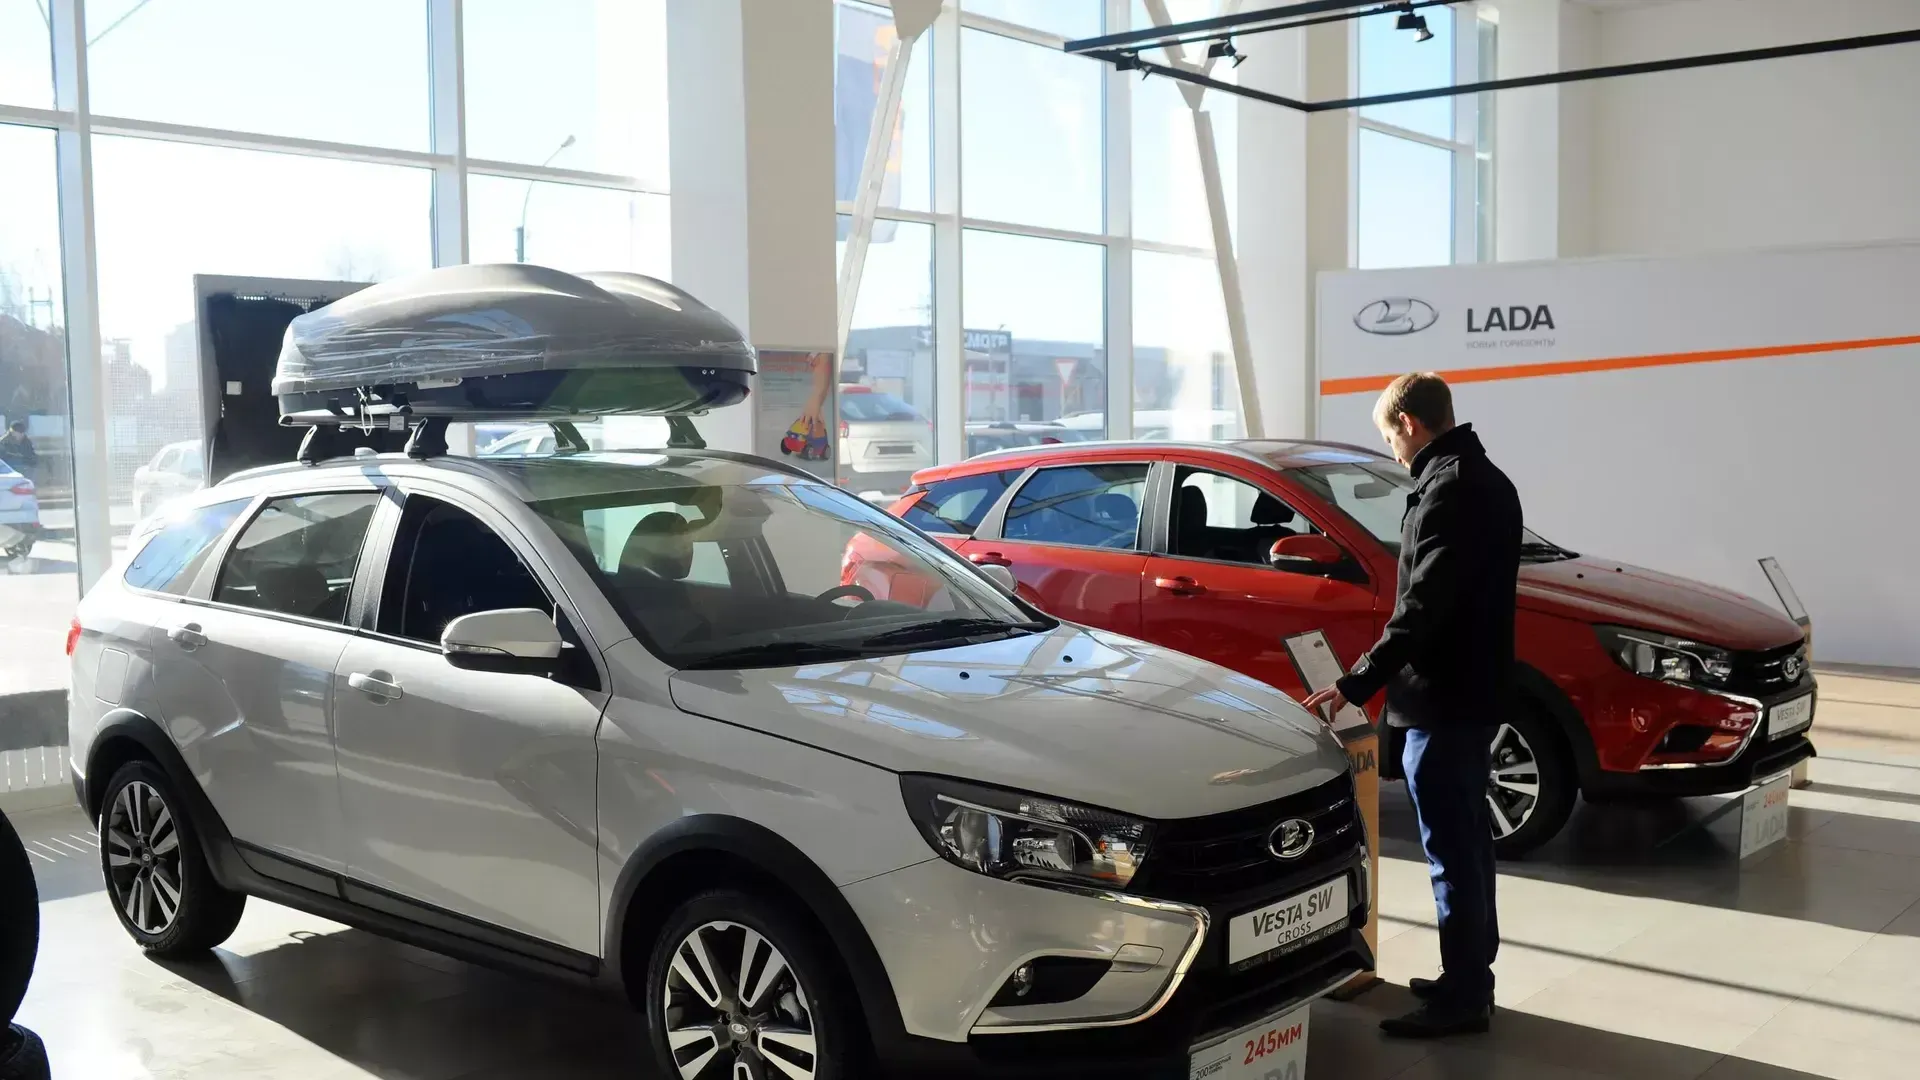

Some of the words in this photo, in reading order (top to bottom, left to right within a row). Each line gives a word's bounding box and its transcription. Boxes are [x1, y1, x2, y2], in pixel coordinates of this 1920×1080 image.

[1467, 304, 1555, 333] LADA
[1252, 902, 1303, 937] VESTA
[1307, 886, 1334, 917] SW
[1277, 921, 1312, 945] CROSS
